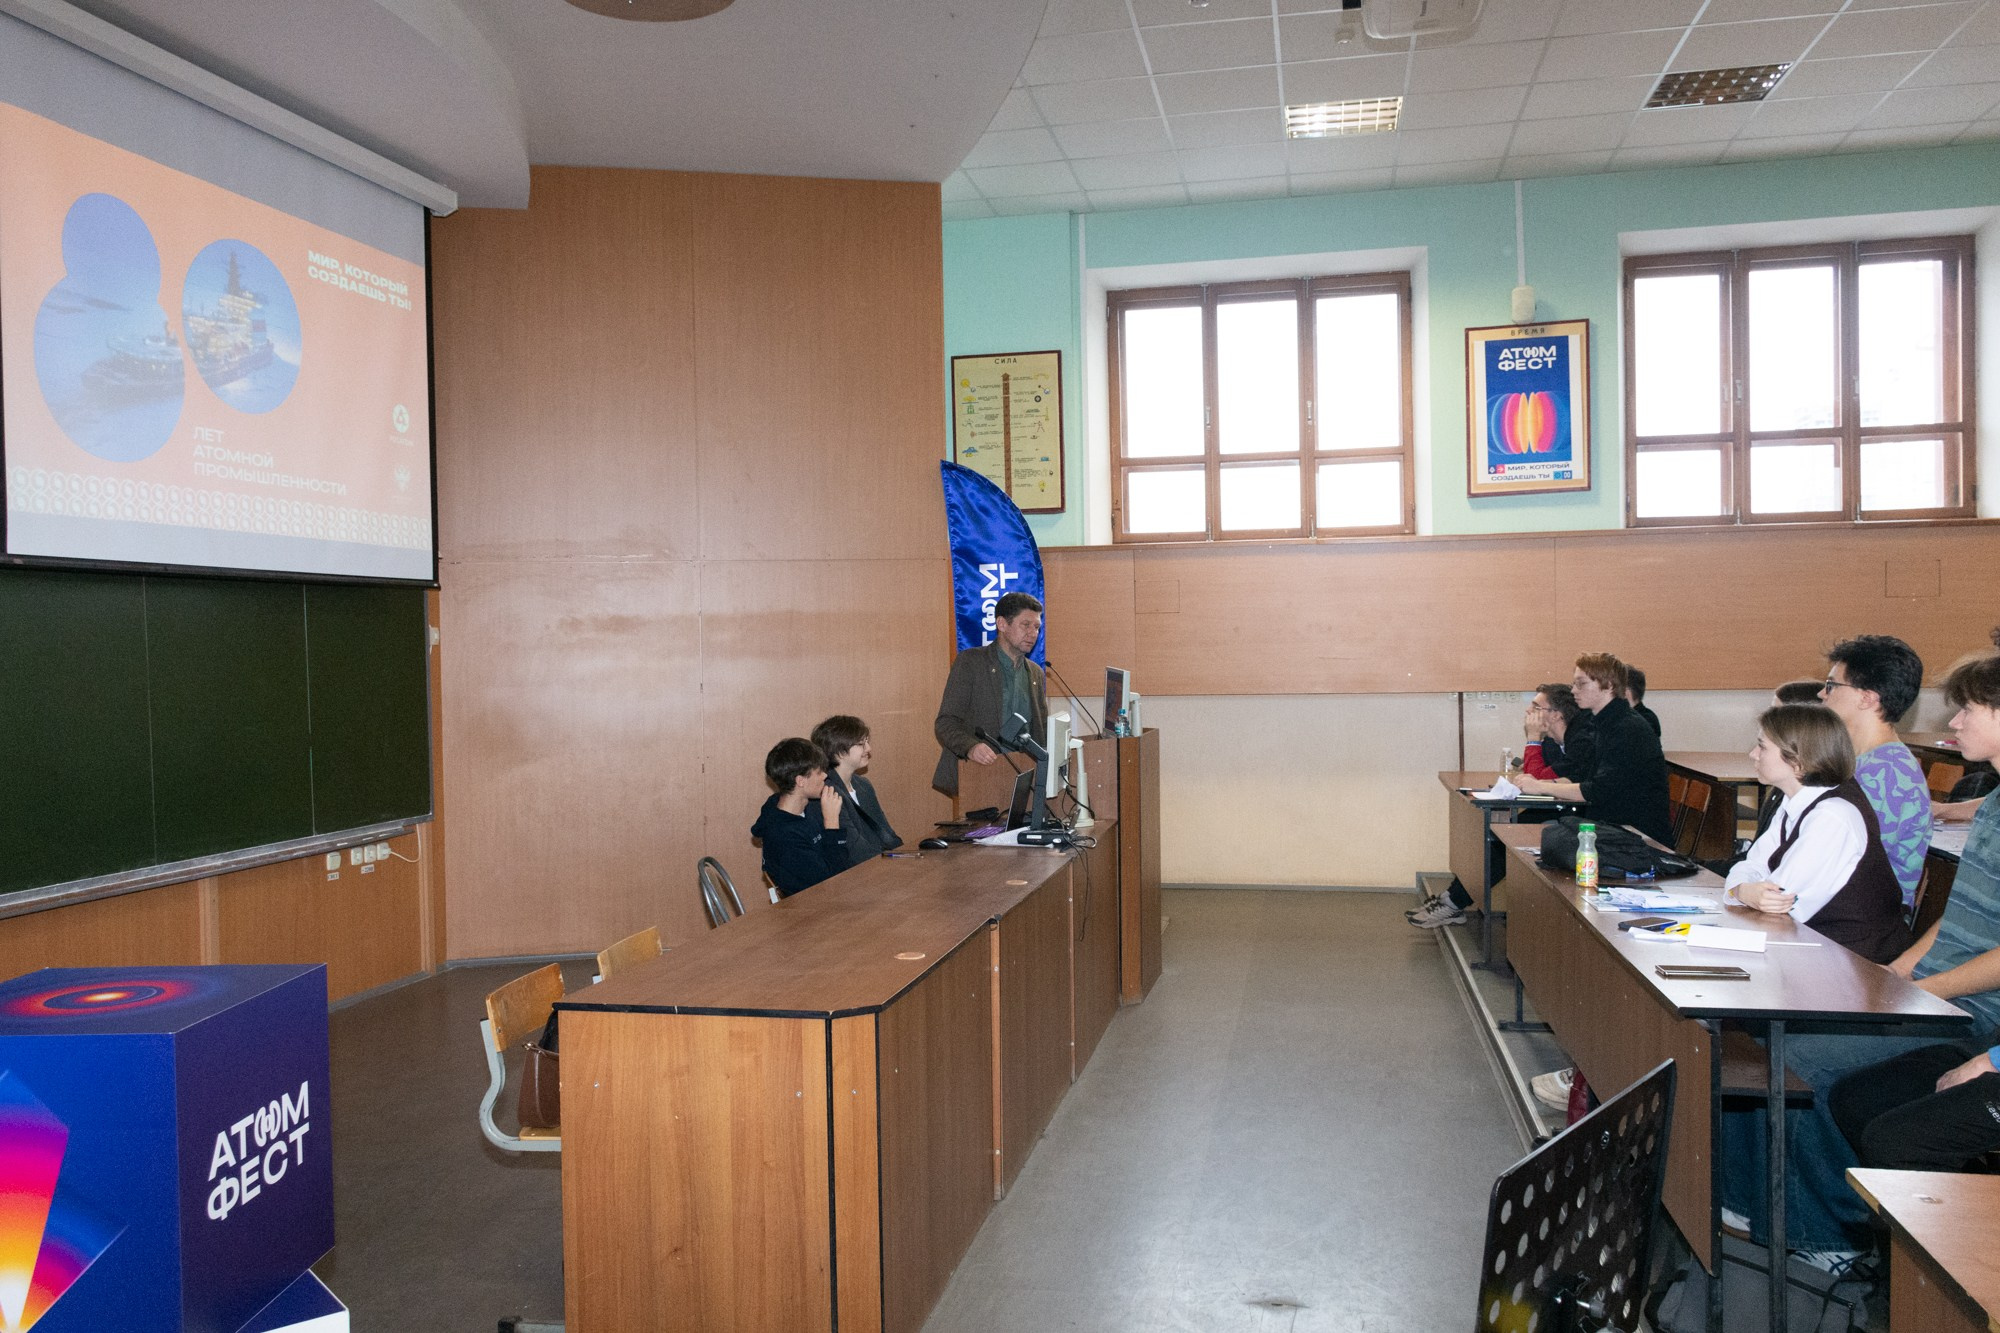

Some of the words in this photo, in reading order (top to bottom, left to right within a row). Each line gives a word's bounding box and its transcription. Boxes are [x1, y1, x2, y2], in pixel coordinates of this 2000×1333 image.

[308, 250, 342, 275] МИР,
[344, 263, 408, 296] КОТОРЫЙ
[307, 265, 386, 302] СОЗДАЕШЬ
[1510, 327, 1545, 337] ВРЕМЯ
[994, 357, 1017, 365] СИЛА
[1497, 357, 1557, 371] ФЕСТ
[193, 426, 225, 443] ЛЕТ
[193, 444, 274, 468] АТОМНОЙ
[1529, 462, 1570, 470] КОТОРЫЙ
[194, 462, 347, 496] ПРОМЫШЛЕННОСТИ
[1491, 473, 1536, 481] СОЗДАЕШЬ
[207, 1121, 310, 1221] ФЕСТ
